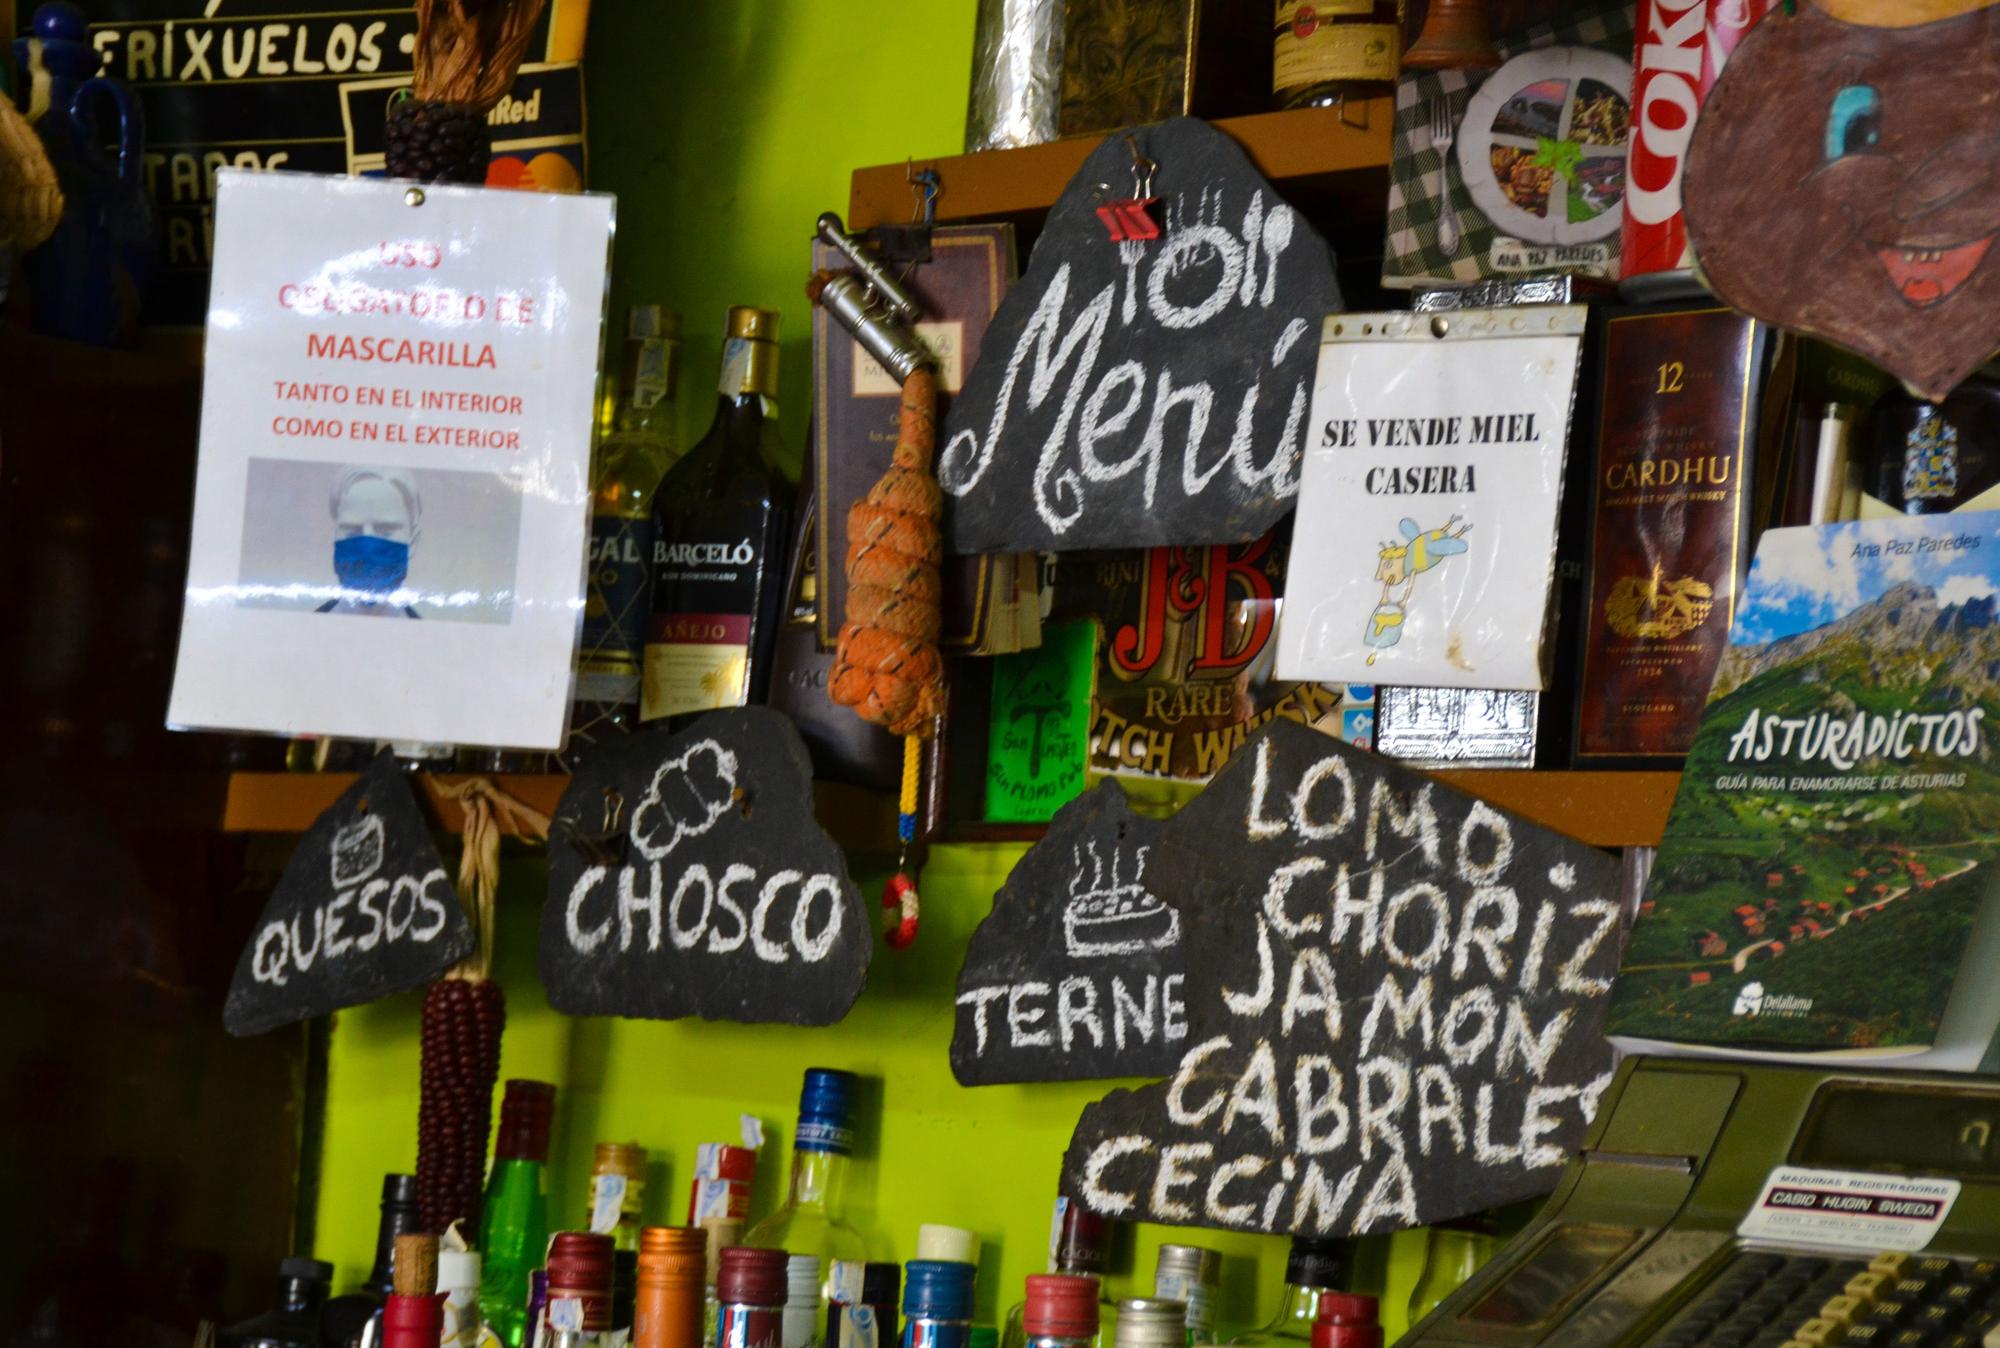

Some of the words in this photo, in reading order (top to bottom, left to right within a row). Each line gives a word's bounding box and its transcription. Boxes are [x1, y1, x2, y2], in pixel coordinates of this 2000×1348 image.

[1627, 0, 1706, 224] COK
[379, 240, 443, 270] USO
[278, 283, 486, 321] OBLGATORO
[495, 296, 536, 325] DE
[307, 333, 497, 370] MASCARILLA
[1655, 360, 1685, 394] 12
[273, 380, 350, 404] TANTO
[356, 386, 385, 407] EN
[391, 388, 415, 408] EL
[420, 390, 523, 416] INTERIOR
[938, 262, 1308, 536] Menú
[272, 415, 343, 439] COMO
[350, 421, 378, 441] EN
[385, 424, 409, 444] EL
[415, 425, 520, 450] EXTERIOR
[1321, 419, 1357, 448] SE
[1366, 417, 1462, 447] VENDE
[1468, 413, 1541, 445] MIEL
[1365, 464, 1477, 496] CASERA
[1605, 455, 1731, 490] CARDHU
[652, 537, 754, 567] BARCELÓ
[1850, 542, 1881, 560] Ana
[1884, 539, 1914, 556] Paz
[1917, 532, 1983, 553] Paredes
[662, 619, 727, 639] AÑEJO
[1145, 685, 1235, 725] RARE
[1727, 707, 1985, 771] ASTURADICTOS
[1715, 773, 1748, 790] GUÍA
[1752, 775, 1786, 791] PARA
[1789, 776, 1877, 791] ENAMORARSE
[1881, 775, 1902, 790] DE
[1901, 773, 1967, 789] ASTURIAS
[1244, 737, 1513, 887] LOMO
[251, 867, 448, 986] QUESOS
[565, 862, 844, 964] CHOSCO
[1221, 912, 1575, 1083] JAMON
[955, 974, 1189, 1058] TERNE
[1080, 1132, 1423, 1236] CECiNA
[1778, 1174, 1843, 1188] MAQUINAS
[1848, 1178, 1949, 1195] REGISTRADORAS
[1771, 1191, 1817, 1207] CASIO
[1821, 1195, 1872, 1211] HUGIN
[1877, 1200, 1937, 1217] SWEDA
